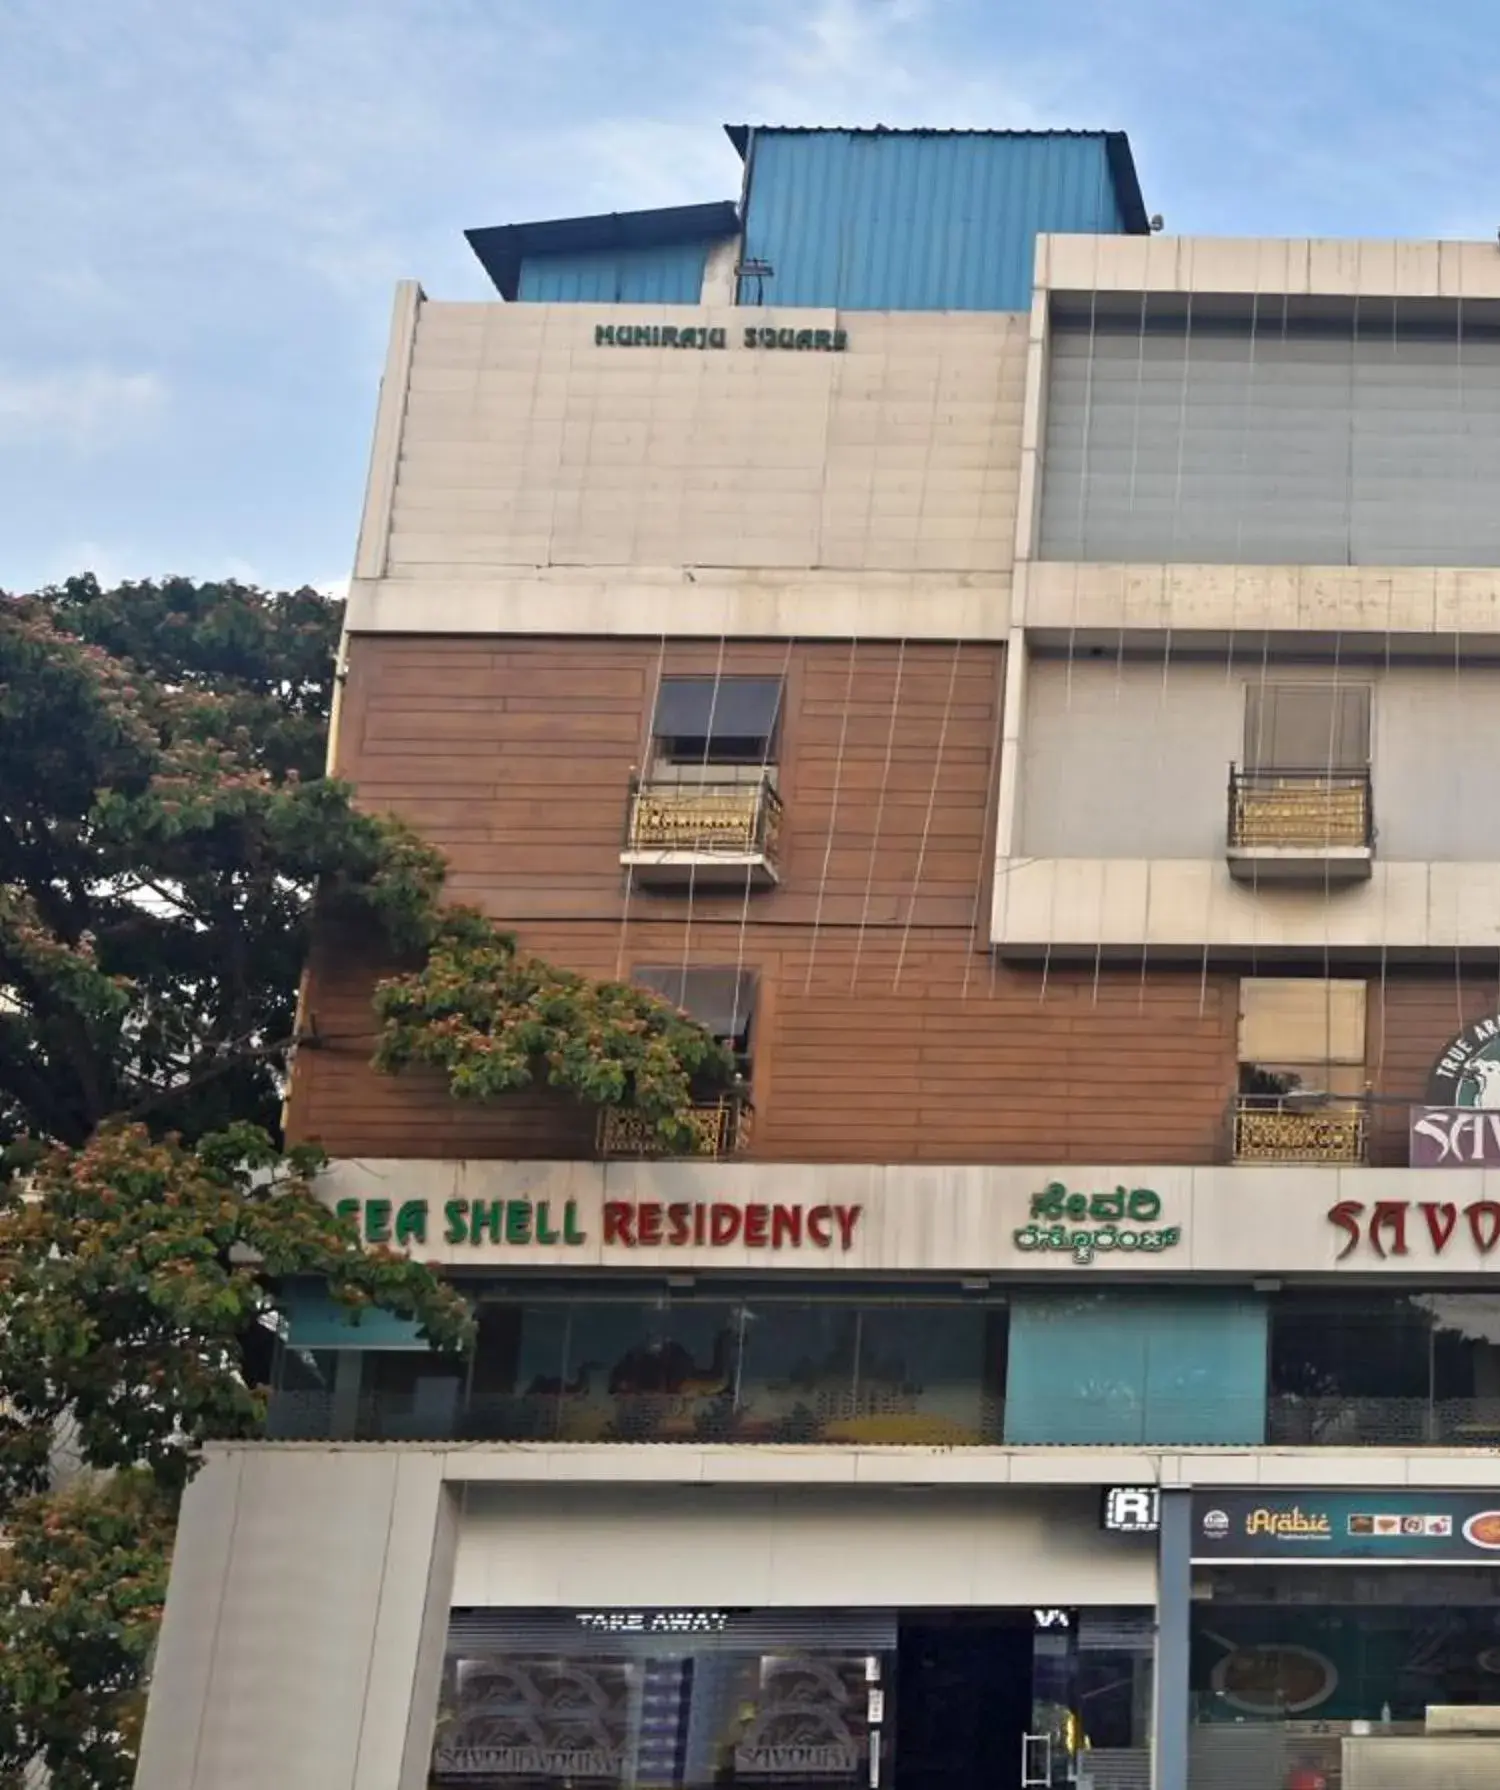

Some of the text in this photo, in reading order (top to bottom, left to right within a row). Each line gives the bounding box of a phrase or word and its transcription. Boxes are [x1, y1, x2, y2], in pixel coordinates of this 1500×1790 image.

[594, 324, 848, 352] MUNIRAJU SQUARE
[1435, 1037, 1474, 1079] TRUE
[443, 1197, 587, 1246] SHELL
[602, 1200, 863, 1252] RESIDENCY
